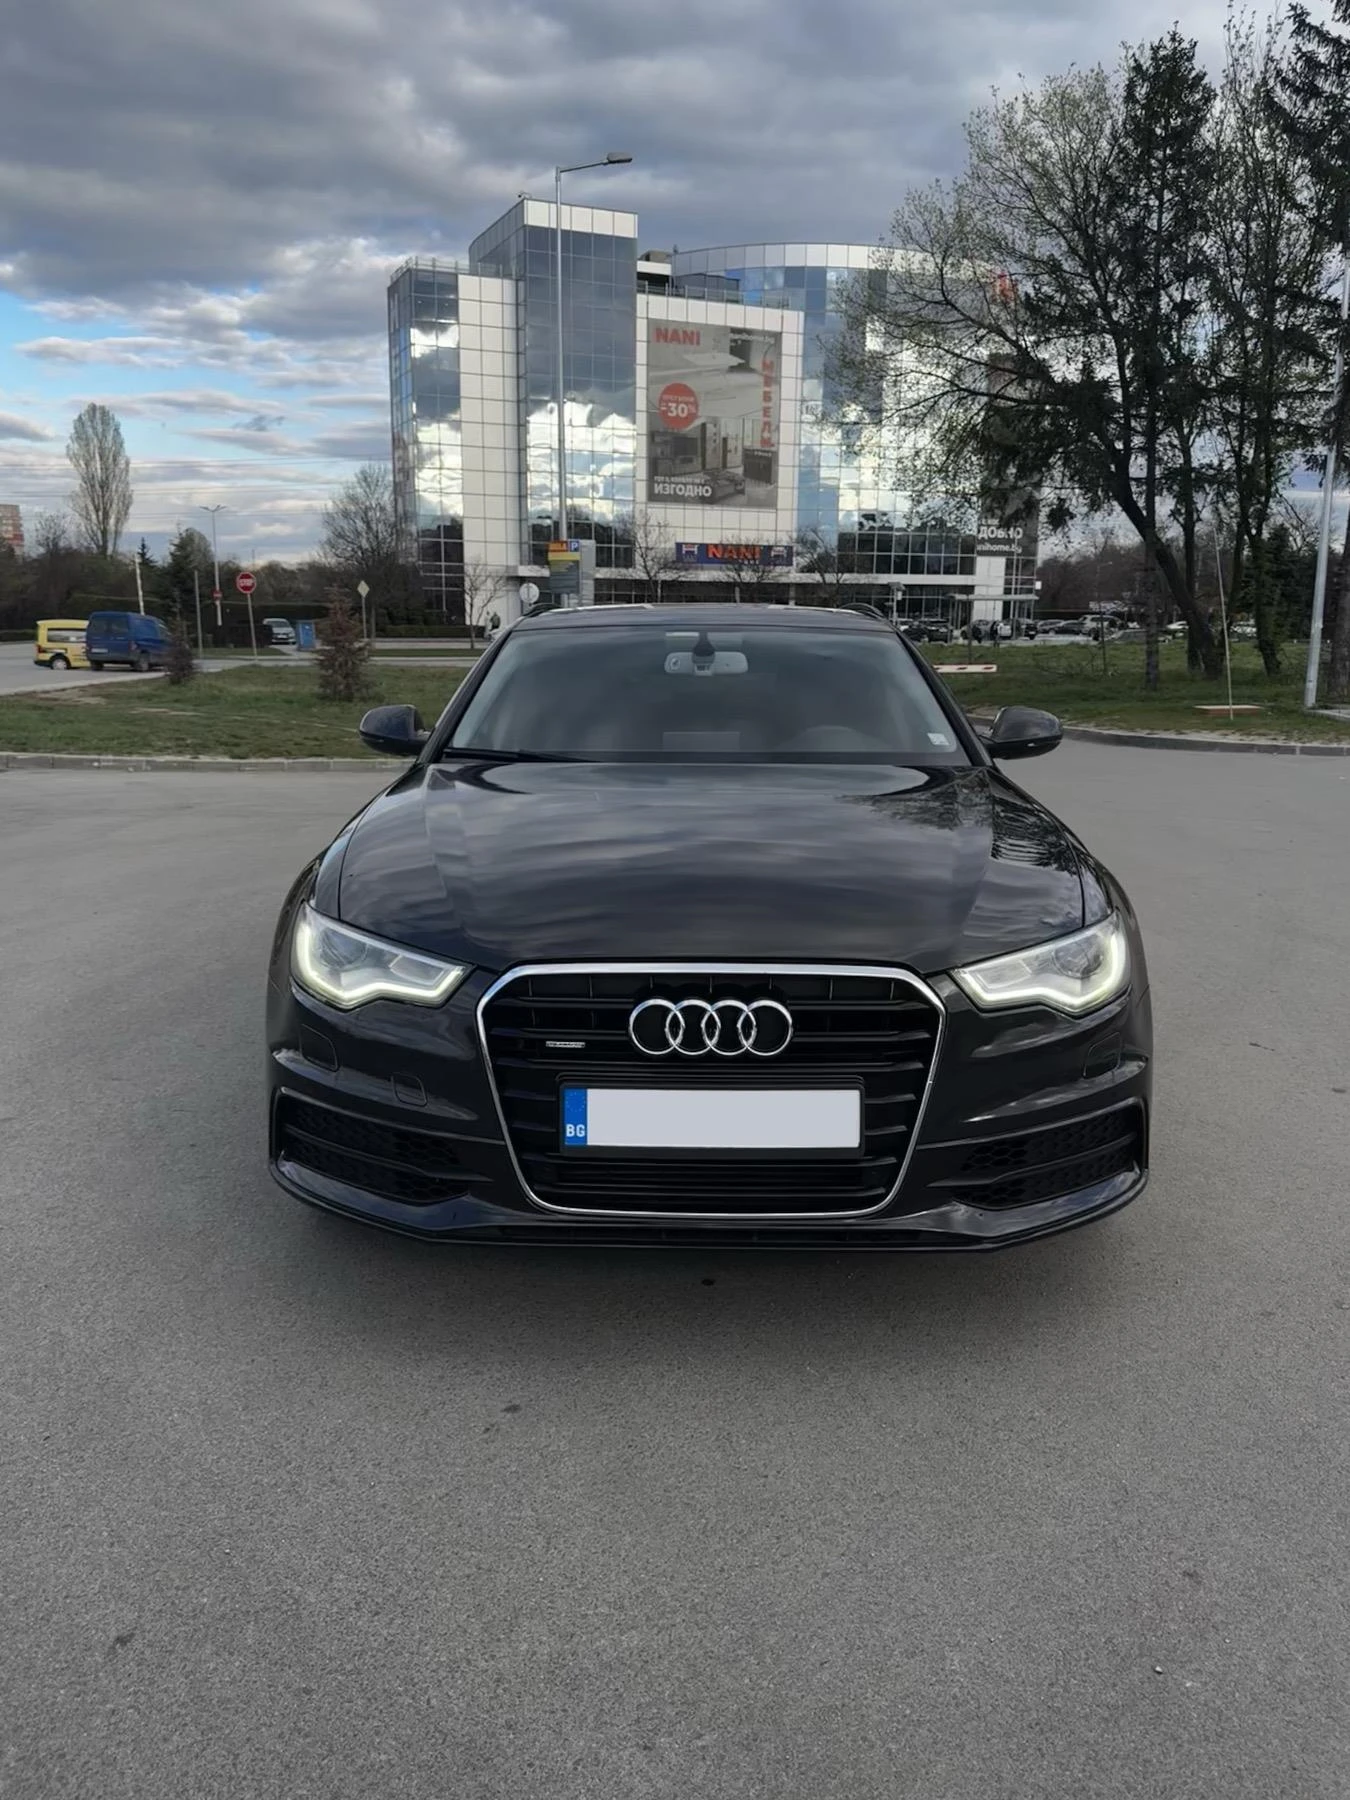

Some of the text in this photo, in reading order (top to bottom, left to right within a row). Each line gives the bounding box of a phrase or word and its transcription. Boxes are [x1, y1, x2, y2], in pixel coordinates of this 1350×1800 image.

[655, 327, 700, 346] NANI
[653, 482, 713, 498] ИЗГОДНО
[706, 543, 761, 559] NANI
[565, 1123, 586, 1138] BG
